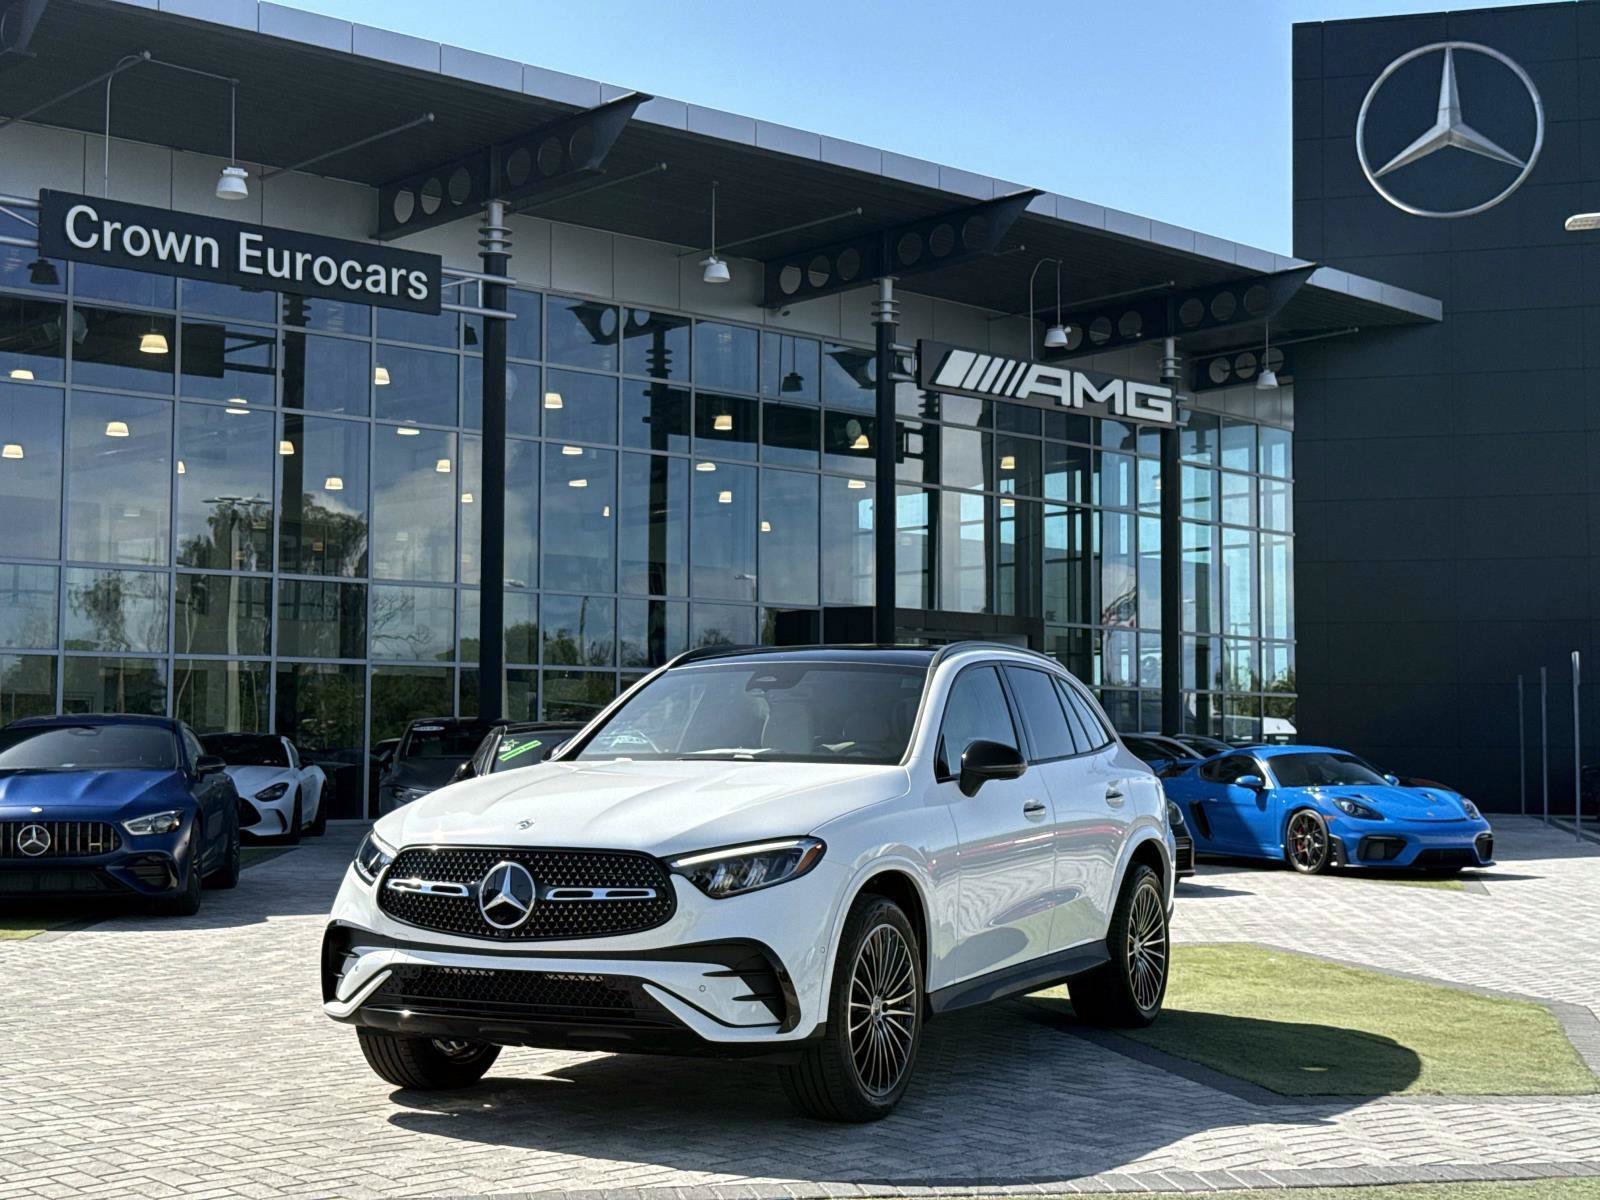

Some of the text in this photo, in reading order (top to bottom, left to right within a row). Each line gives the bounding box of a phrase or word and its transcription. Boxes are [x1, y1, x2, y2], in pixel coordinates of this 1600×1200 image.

[65, 204, 429, 300] Crown Eurocars
[1015, 363, 1172, 423] AMG
